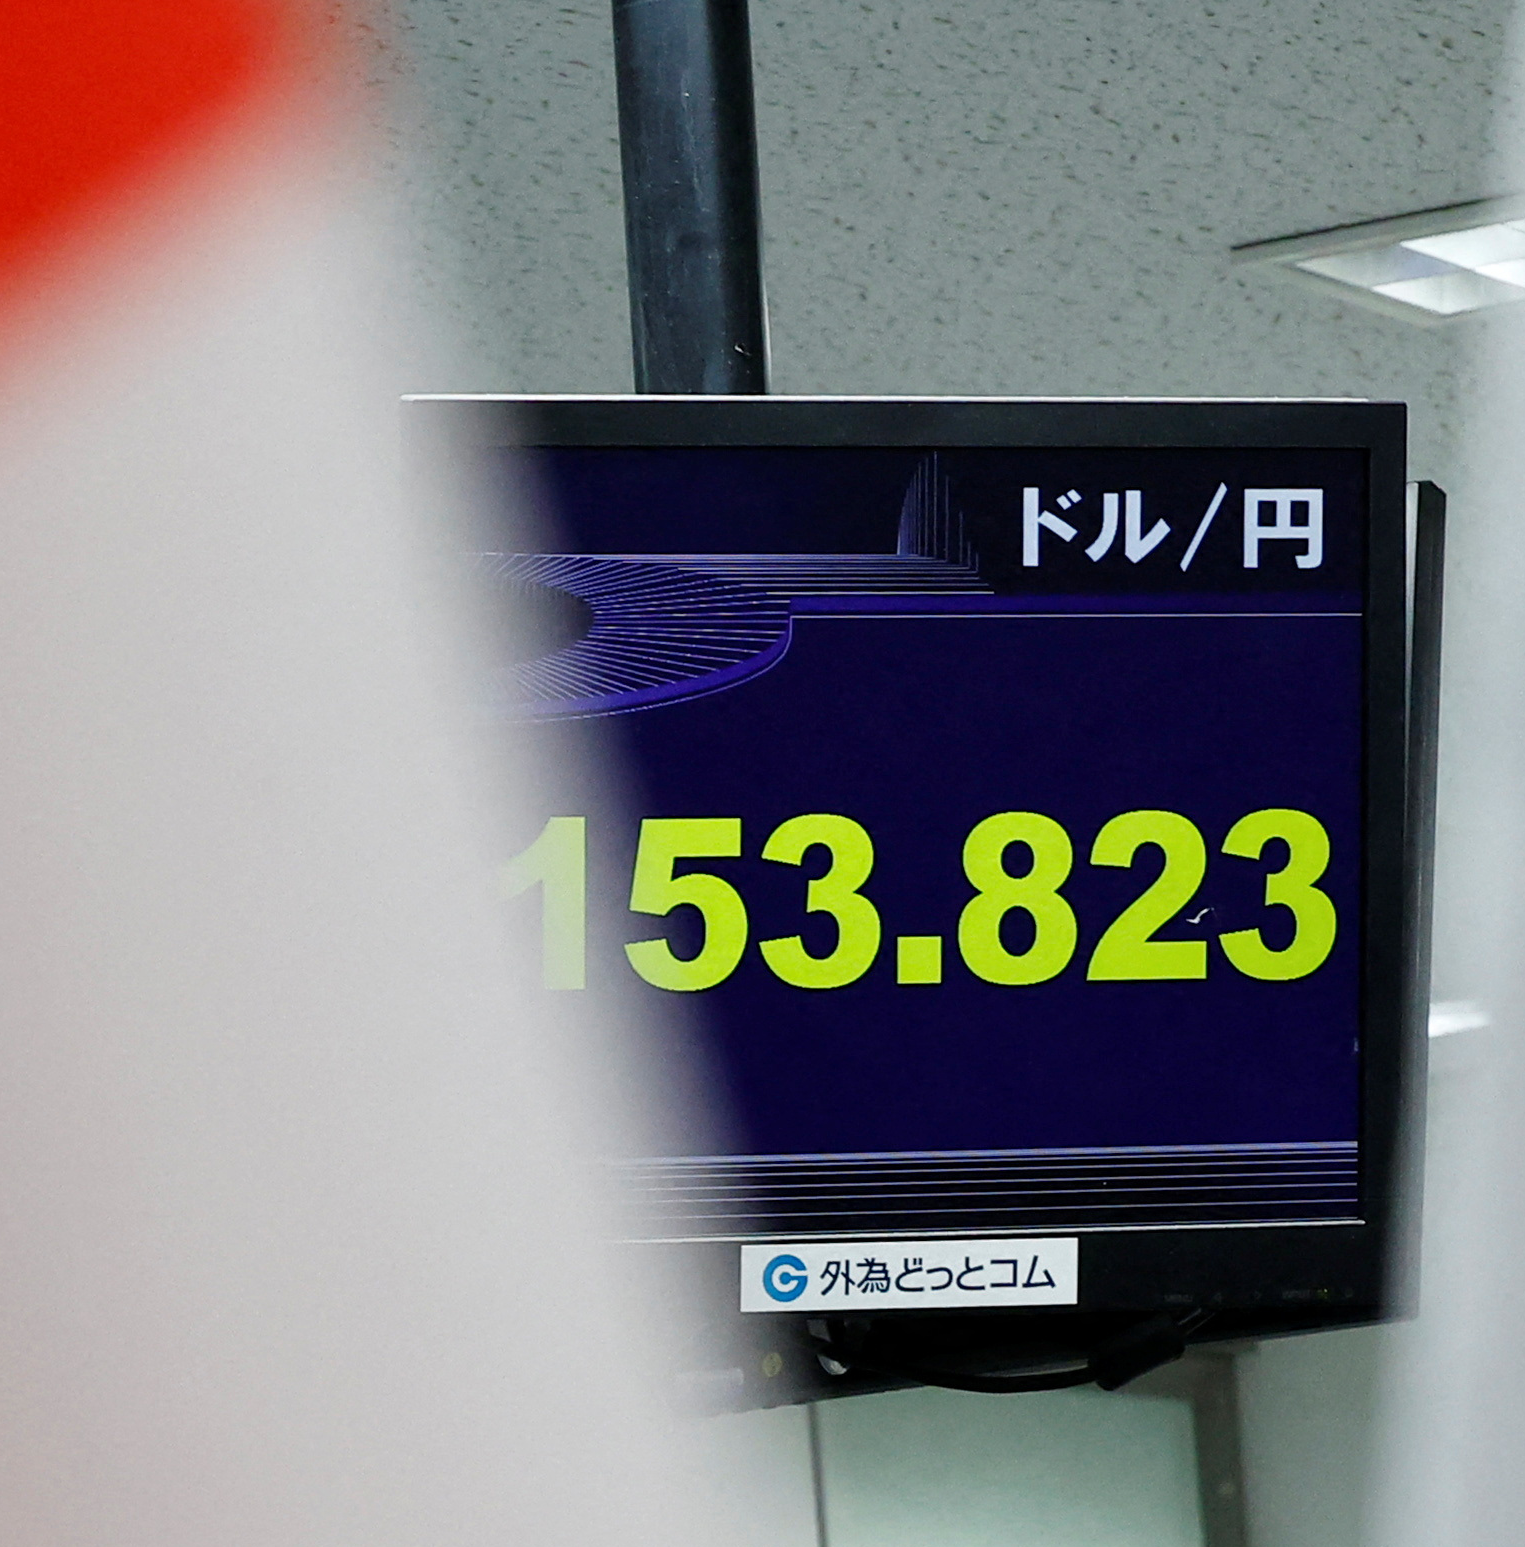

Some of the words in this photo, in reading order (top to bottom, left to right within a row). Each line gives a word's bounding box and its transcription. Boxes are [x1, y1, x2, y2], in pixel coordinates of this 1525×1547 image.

[1021, 482, 1324, 572] ドル/円
[499, 808, 1337, 992] 153.823
[819, 1255, 1056, 1296] 外為どっとコム
